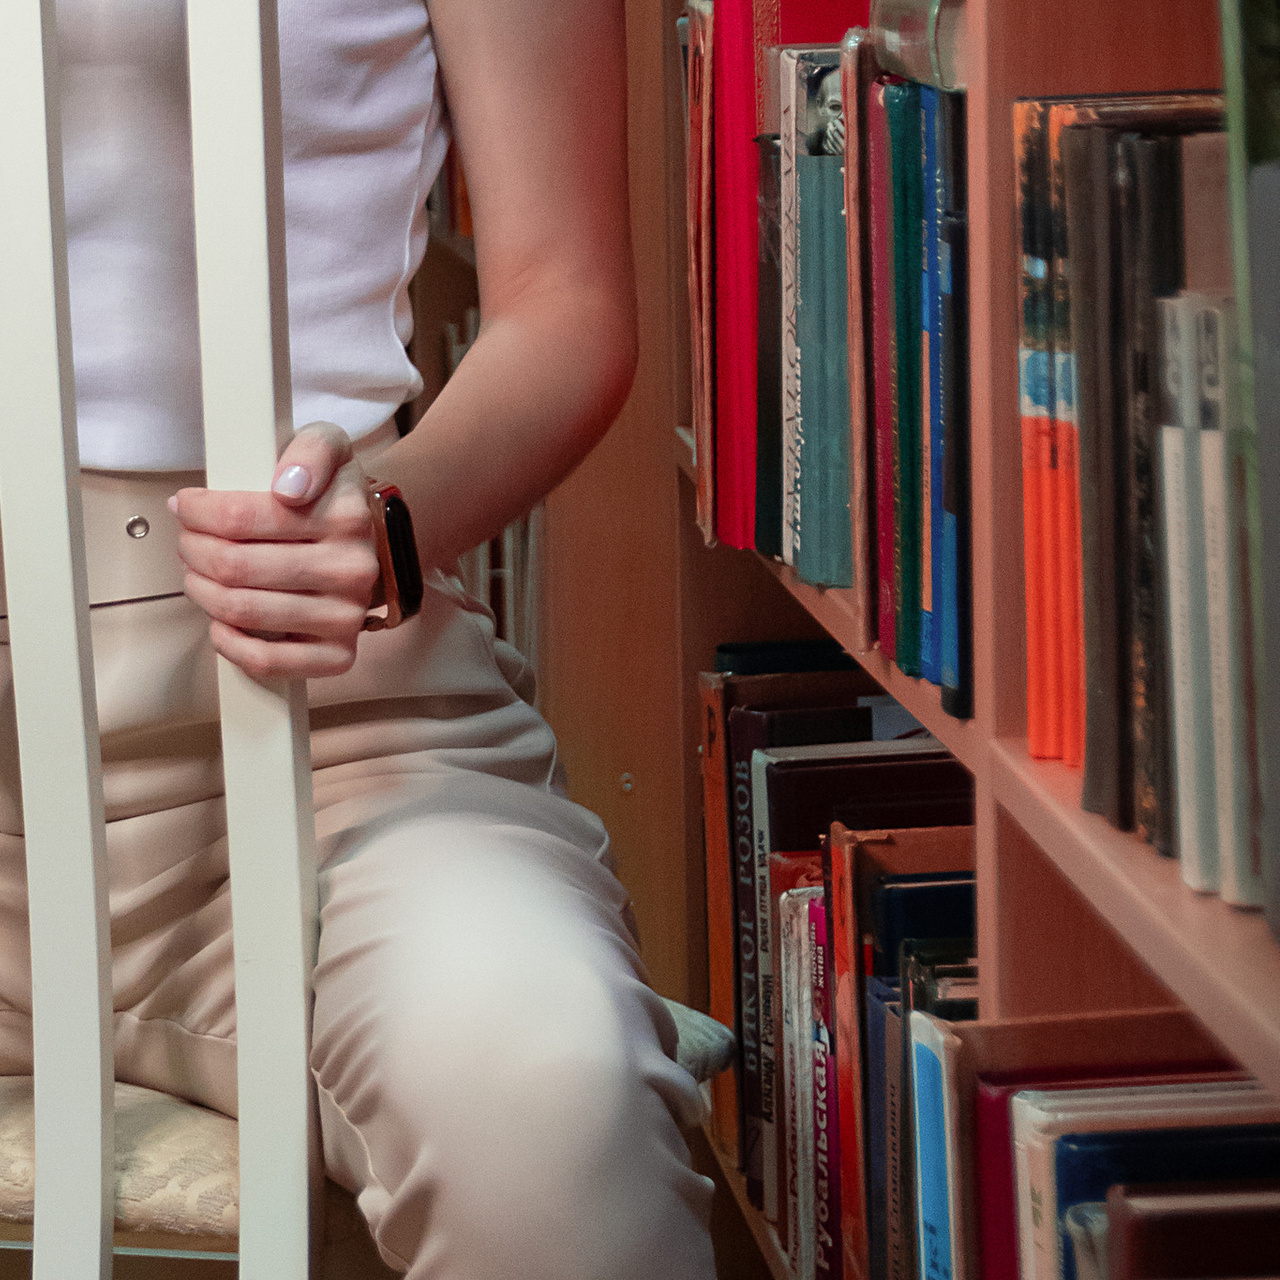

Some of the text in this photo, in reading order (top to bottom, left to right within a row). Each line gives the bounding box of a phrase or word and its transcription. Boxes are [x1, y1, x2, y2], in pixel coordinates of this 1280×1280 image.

[735, 761, 759, 1074] ВИКТОР РОЗОВ
[812, 1040, 833, 1271] Рубальская
